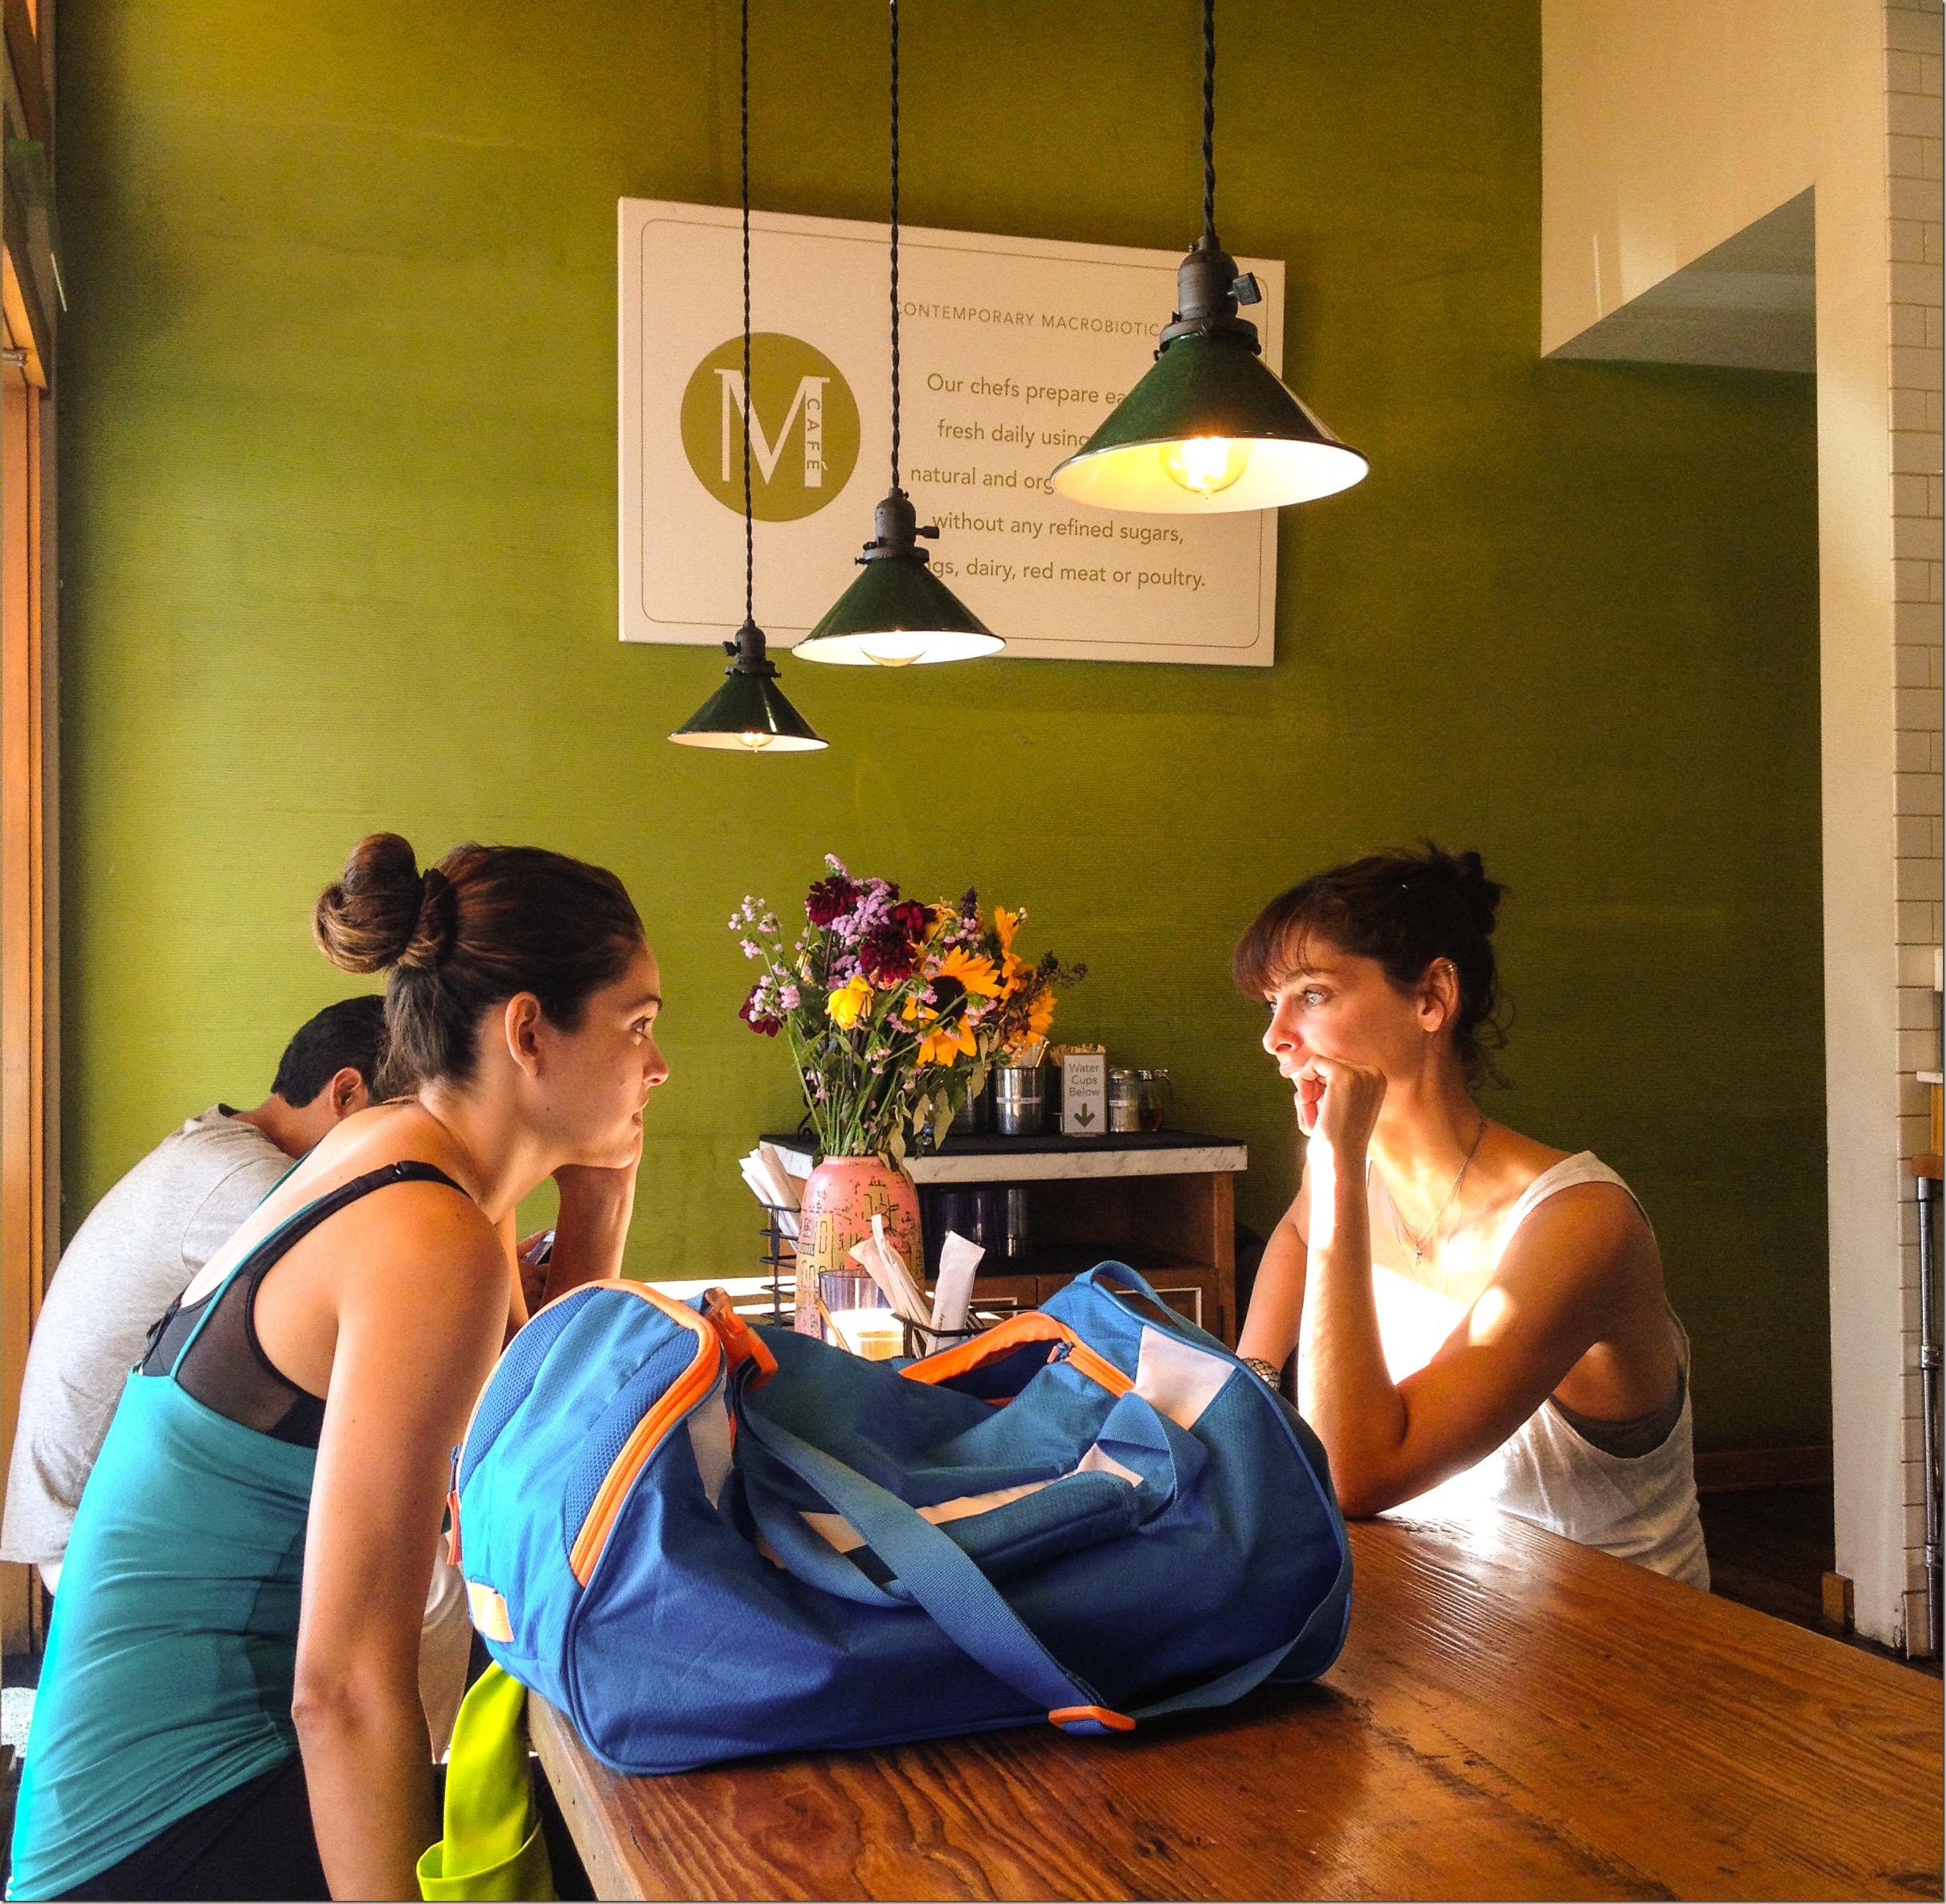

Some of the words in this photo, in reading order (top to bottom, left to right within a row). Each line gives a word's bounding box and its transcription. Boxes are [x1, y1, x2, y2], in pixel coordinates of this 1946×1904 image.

[927, 373, 964, 392] Our
[971, 375, 1020, 397] chefs
[1026, 385, 1099, 407] prepare
[713, 367, 831, 488] M
[806, 398, 829, 471] CAFÉ
[937, 417, 984, 440] fresh
[991, 423, 1036, 448] daily
[910, 467, 976, 485] natural
[983, 470, 1017, 487] and
[932, 511, 1005, 533] without
[1010, 521, 1043, 540] any
[1049, 517, 1113, 538] refined
[1120, 526, 1184, 544] sugars,
[966, 557, 1017, 583] dairy,
[1023, 561, 1054, 579] red
[1060, 567, 1106, 583] meat
[1113, 571, 1133, 583] or
[1138, 567, 1206, 591] poultry.
[1069, 1064, 1100, 1073] Water
[1071, 1075, 1098, 1087] Cups
[1069, 1087, 1100, 1097] Below
